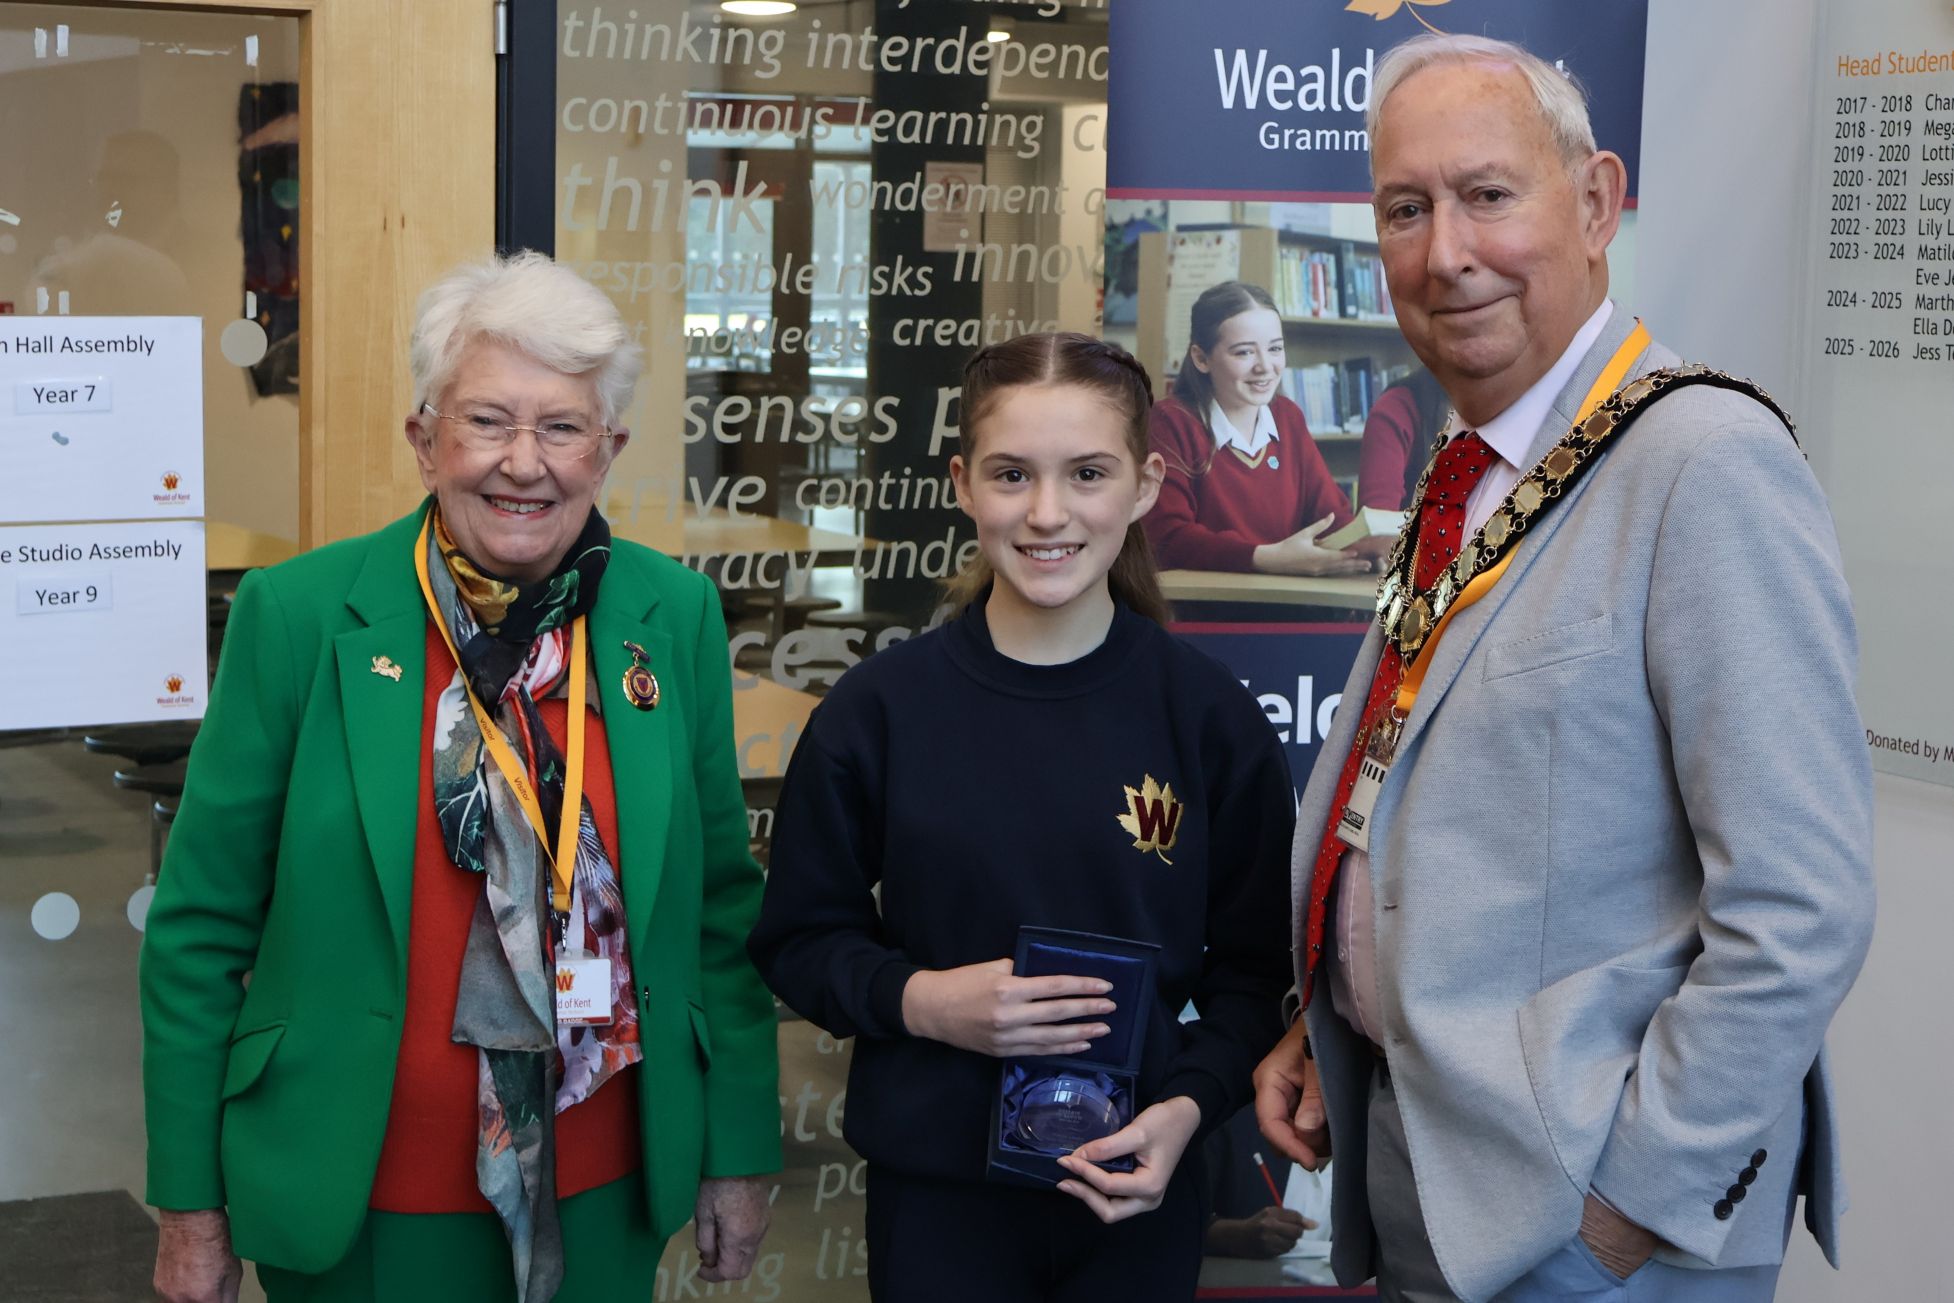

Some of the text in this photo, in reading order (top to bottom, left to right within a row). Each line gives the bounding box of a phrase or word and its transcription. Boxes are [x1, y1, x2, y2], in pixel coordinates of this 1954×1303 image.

[563, 7, 786, 79] thinking
[1838, 52, 1881, 77] Head
[1214, 48, 1373, 112] Weald
[1836, 97, 1867, 115] 2017
[1881, 94, 1913, 113] 2018
[562, 90, 1107, 158] continuous learning c
[1835, 121, 1866, 139] 2018
[1880, 119, 1912, 137] 2019
[1259, 122, 1369, 152] Gramm
[1834, 145, 1864, 163] 2019
[1878, 144, 1910, 162] 2020
[1833, 169, 1863, 187] 2020
[1877, 169, 1907, 187] 2021
[1921, 168, 1954, 186] Jessi
[561, 157, 767, 234] think
[809, 171, 1068, 215] wonderment
[1832, 194, 1860, 211] 2021
[1876, 193, 1907, 211] 2022
[1920, 193, 1951, 216] Lucy
[1830, 218, 1860, 235] 2022
[1875, 218, 1906, 236] 2023
[1918, 218, 1942, 240] Lily
[1829, 242, 1859, 260] 2023
[1874, 242, 1905, 260] 2024
[836, 255, 933, 297] risks
[1916, 268, 1940, 286] Eve
[1827, 290, 1857, 308] 2024
[1871, 291, 1902, 309] 2025
[1913, 317, 1954, 336] Ella D
[16, 335, 53, 353] Hall
[60, 335, 155, 356] Assembly
[1825, 337, 1855, 356] 2025
[1869, 339, 1900, 359] 2026
[1912, 341, 1941, 361] Jess
[1945, 343, 1954, 361] T
[33, 385, 96, 403] Year 7
[682, 394, 900, 444] senses
[0, 540, 182, 563] e Studio Assembly
[35, 586, 98, 606] Year 9
[1866, 729, 1919, 755] Donated
[1924, 740, 1939, 764] by
[514, 777, 530, 801] Visitor
[1134, 795, 1179, 846] W
[564, 998, 573, 1009] of
[574, 998, 592, 1009] Kent
